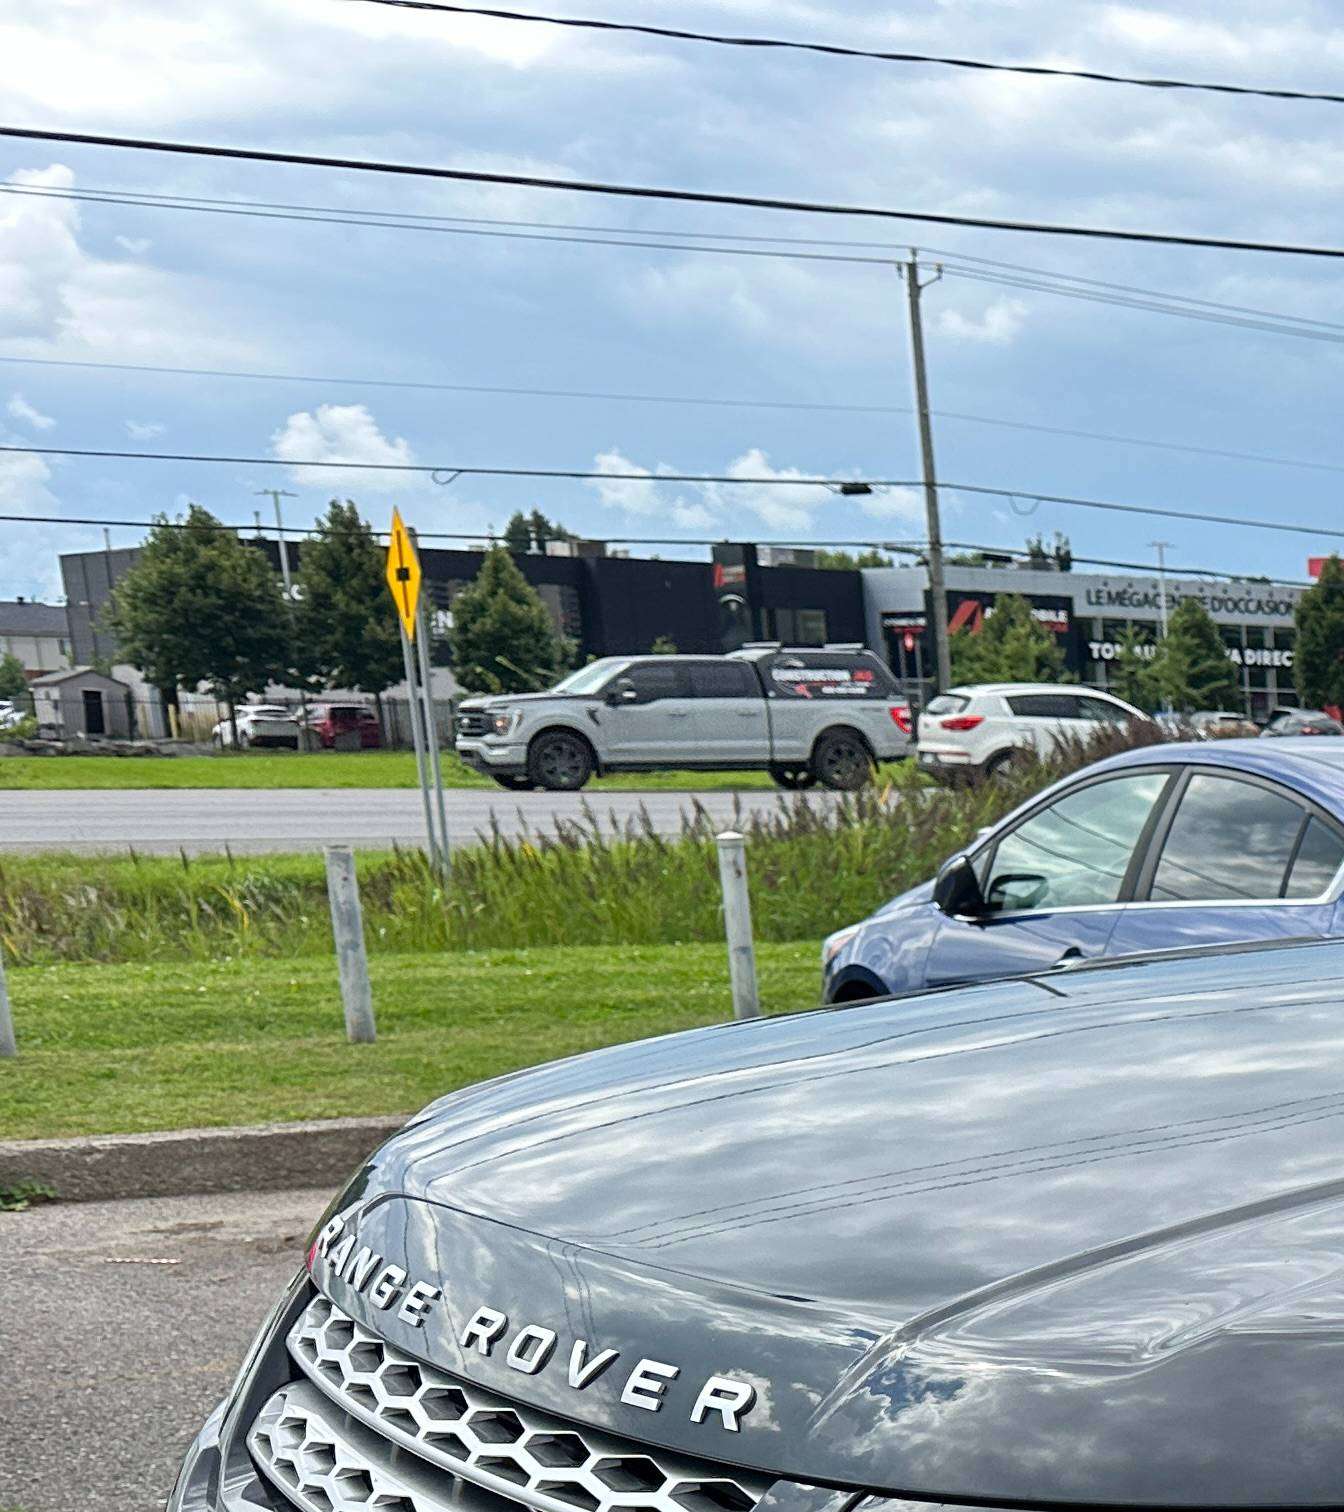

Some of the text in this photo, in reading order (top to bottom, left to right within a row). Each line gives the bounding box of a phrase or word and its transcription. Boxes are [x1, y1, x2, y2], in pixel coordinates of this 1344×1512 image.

[1085, 589, 1104, 606] LE
[1244, 649, 1296, 667] DIREC
[316, 1215, 758, 1433] RANGE ROVER
